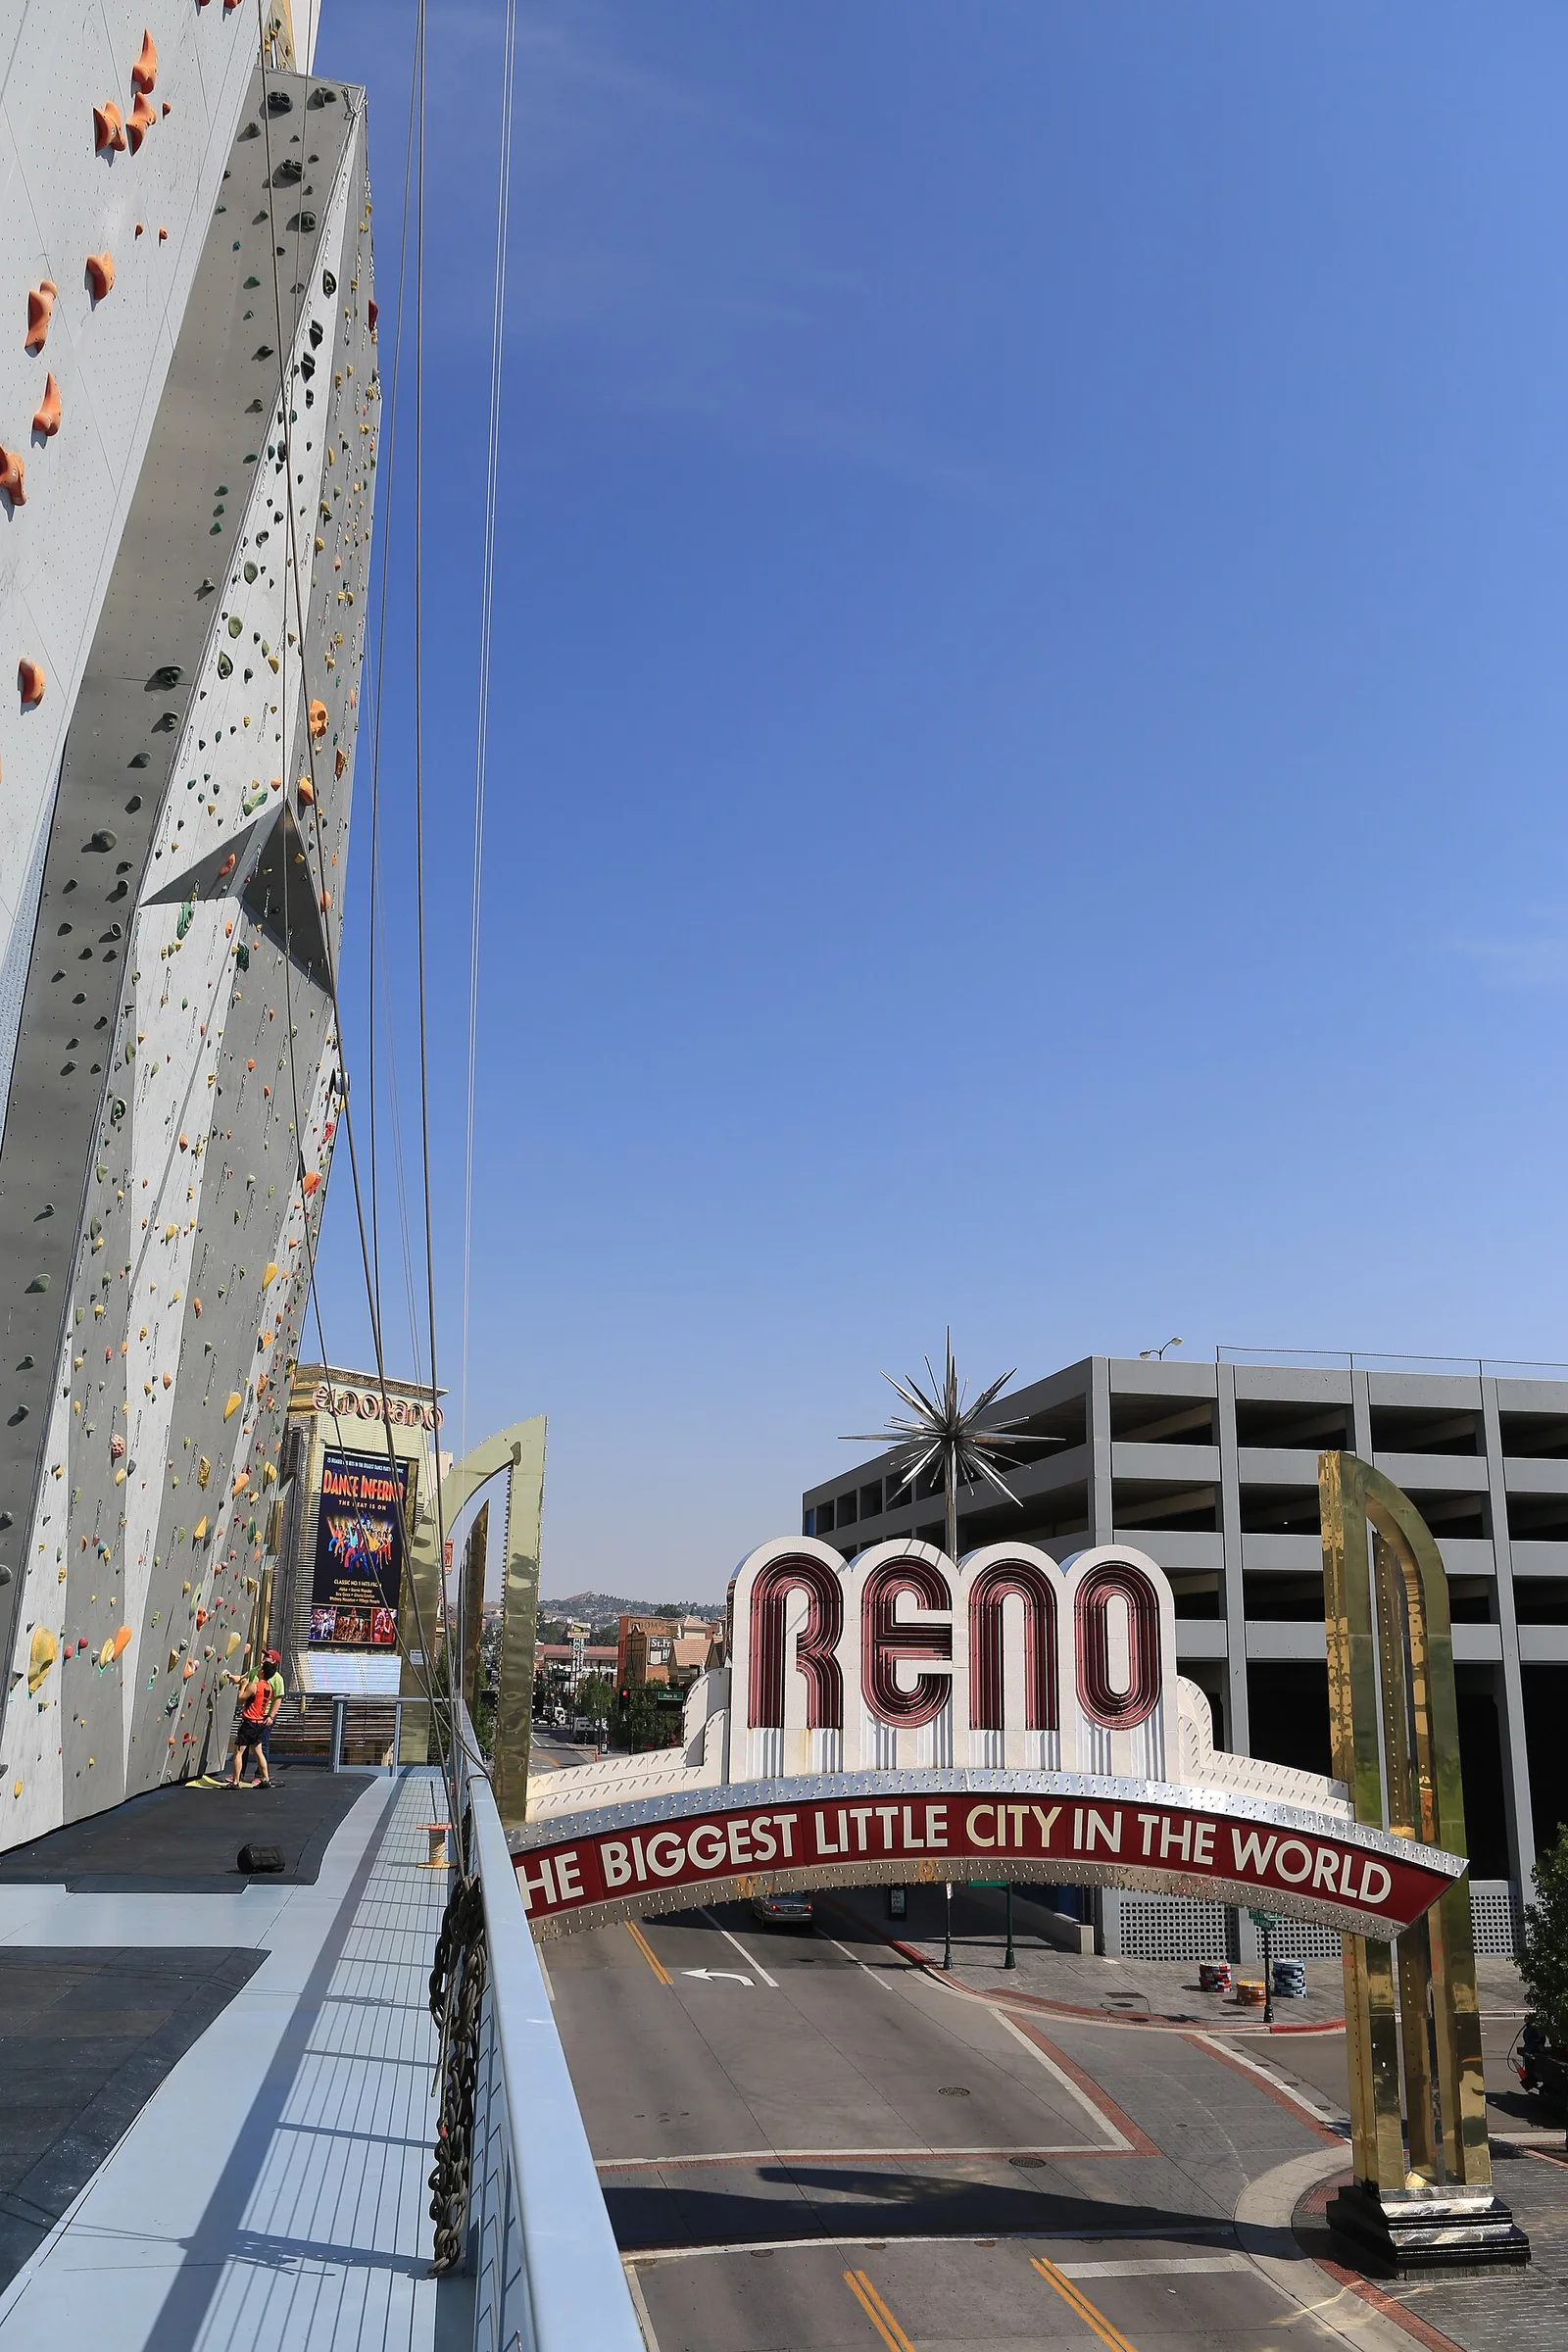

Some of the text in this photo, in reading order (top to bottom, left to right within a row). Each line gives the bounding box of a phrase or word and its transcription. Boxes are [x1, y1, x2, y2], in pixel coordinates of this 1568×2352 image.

[322, 1469, 404, 1503] DANCE INFERNO
[516, 1805, 1392, 1911] HE BIGGEST LITTLE CITY IN THE WORLD
